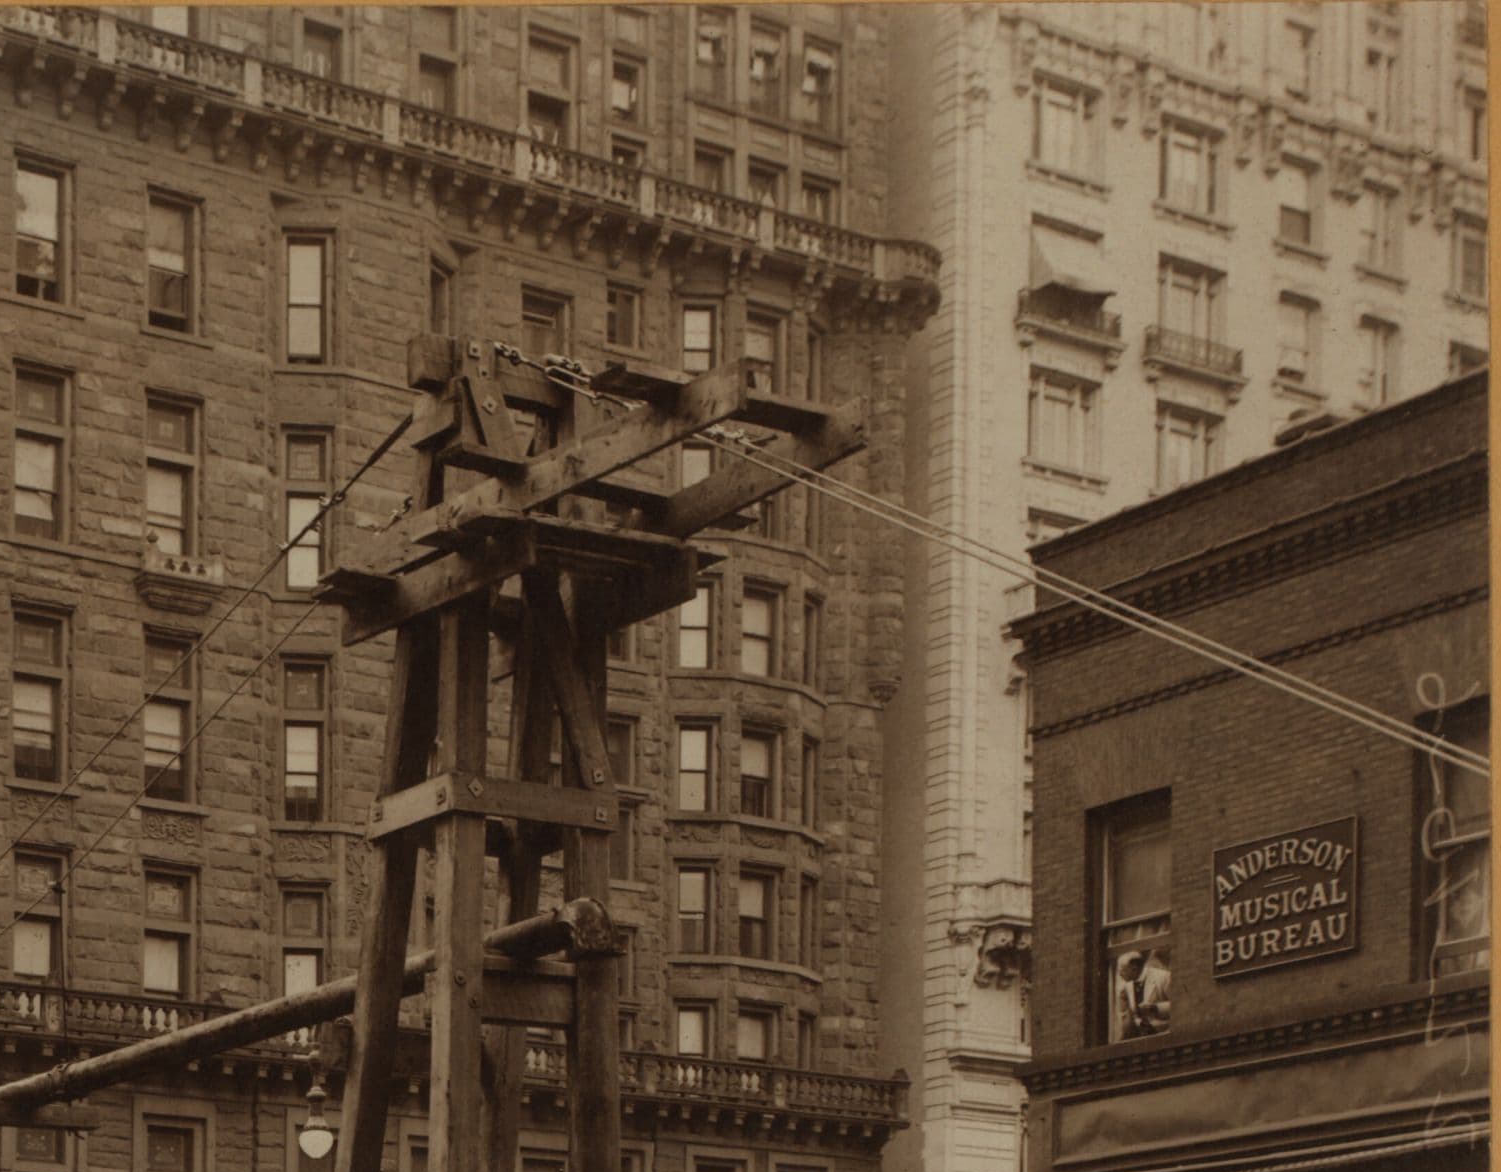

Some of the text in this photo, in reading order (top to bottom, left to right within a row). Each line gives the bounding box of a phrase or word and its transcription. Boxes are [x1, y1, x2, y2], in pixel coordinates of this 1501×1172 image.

[1215, 836, 1353, 901] ANDERSON
[1219, 878, 1348, 931] MUSICAL
[1214, 912, 1348, 966] BUREAU
